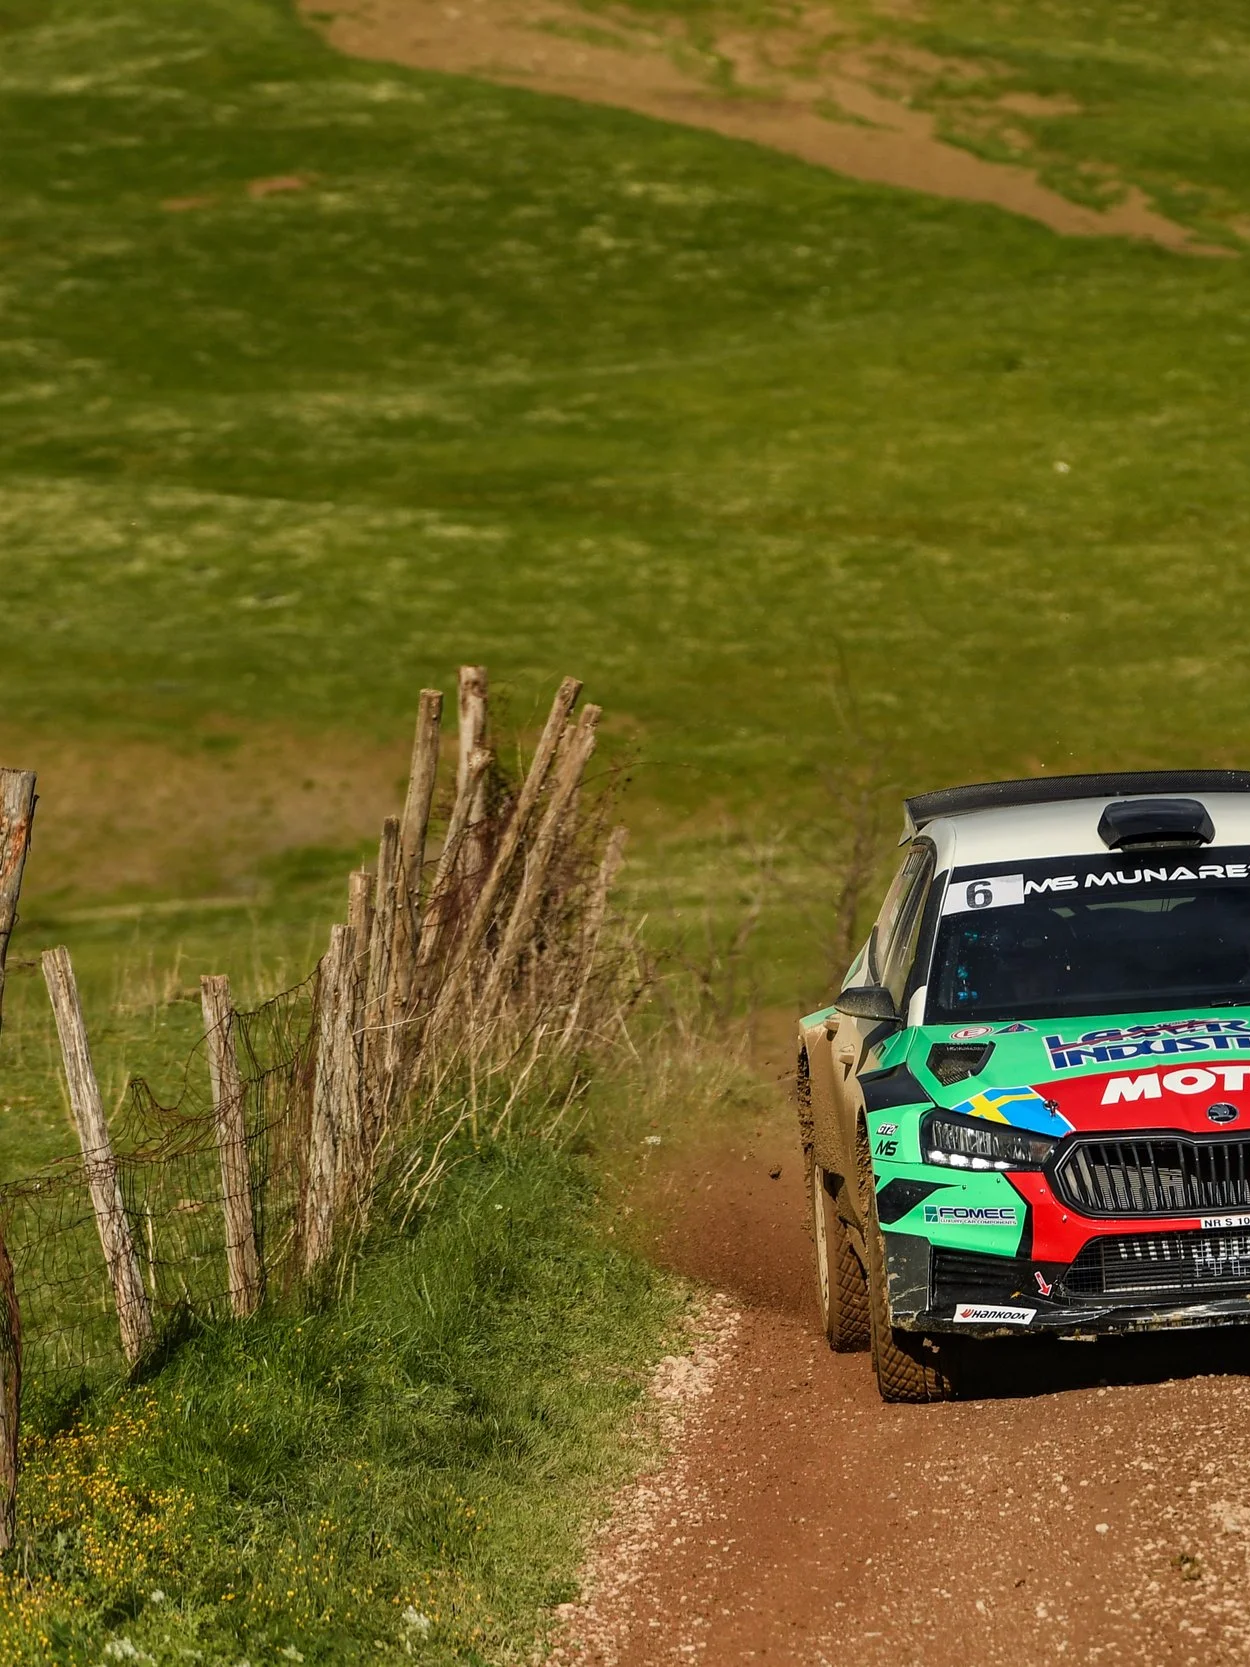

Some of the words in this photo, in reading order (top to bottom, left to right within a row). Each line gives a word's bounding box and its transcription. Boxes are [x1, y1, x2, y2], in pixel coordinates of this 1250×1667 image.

[1024, 874, 1078, 895] MS
[965, 880, 993, 909] 6
[875, 1140, 899, 1156] MS
[940, 1208, 1015, 1219] FOMEC
[1225, 1218, 1233, 1226] S
